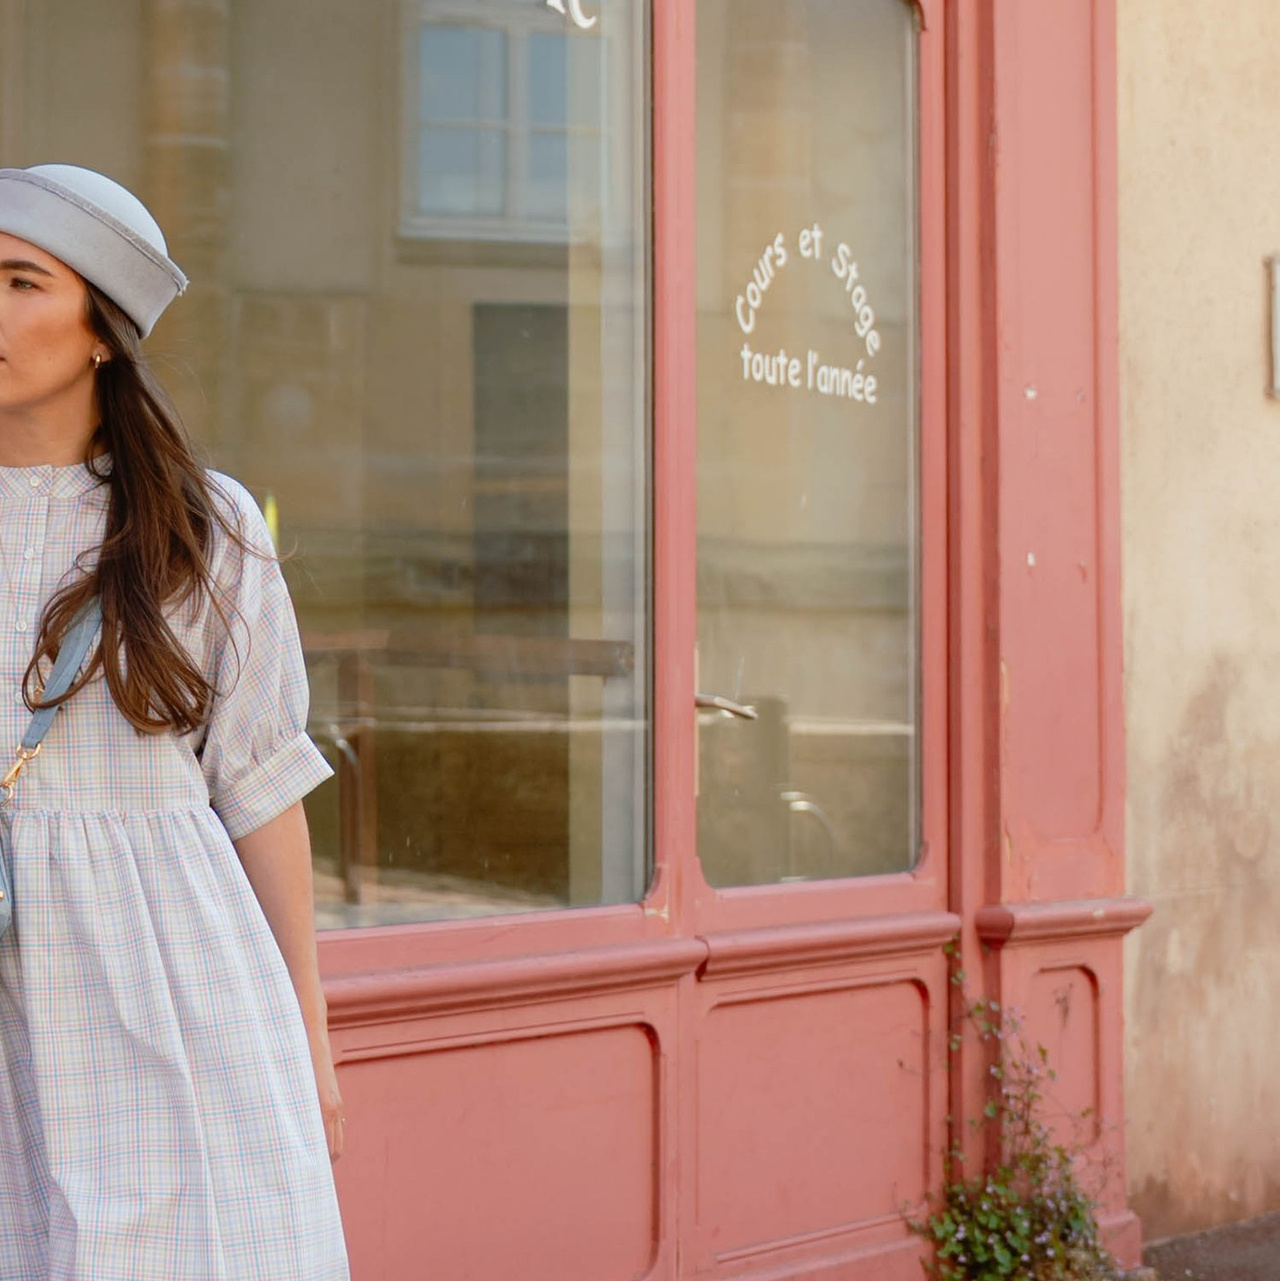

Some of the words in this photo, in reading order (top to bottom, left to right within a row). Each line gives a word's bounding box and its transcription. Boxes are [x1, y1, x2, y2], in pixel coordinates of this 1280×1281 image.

[735, 232, 788, 334] Cours
[798, 223, 823, 260] et
[831, 242, 881, 357] Stage
[740, 342, 802, 387] toute
[807, 349, 878, 404] l'année
